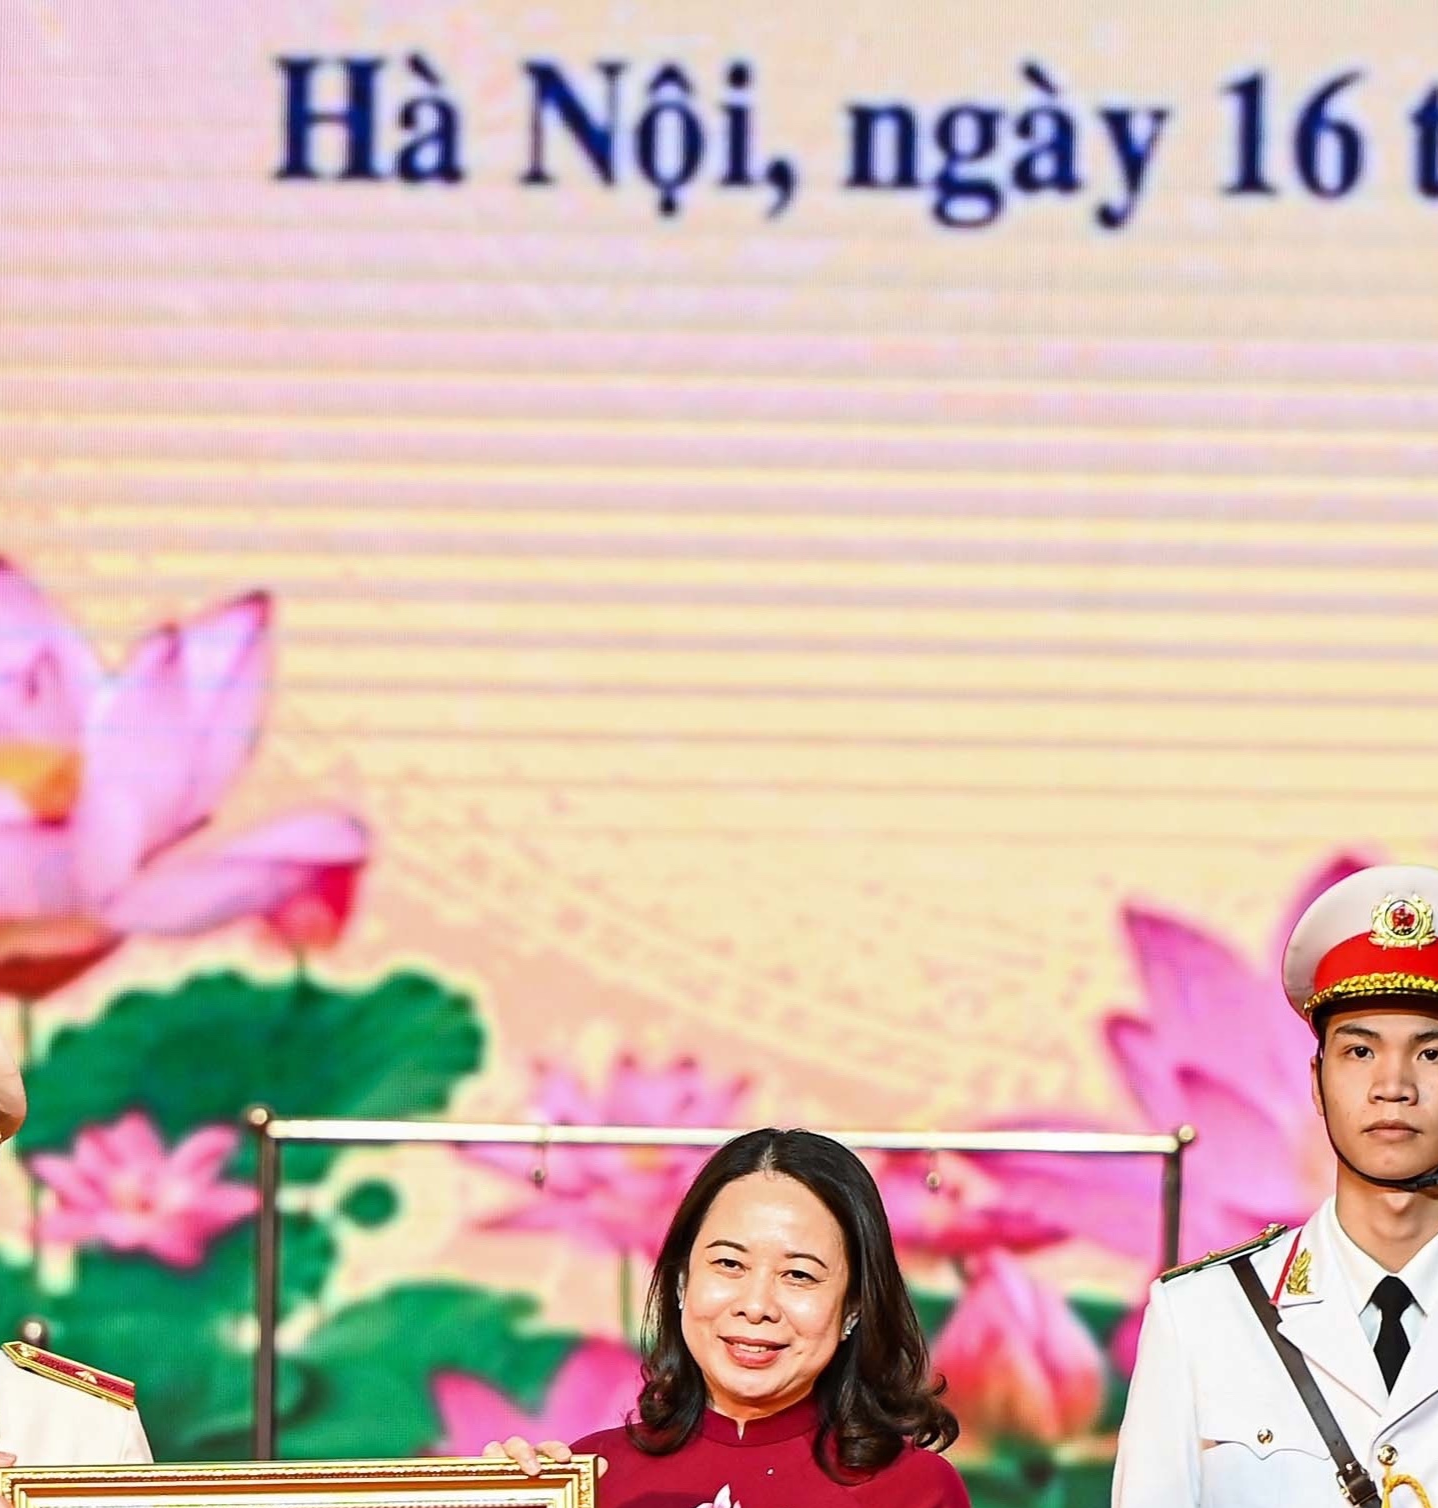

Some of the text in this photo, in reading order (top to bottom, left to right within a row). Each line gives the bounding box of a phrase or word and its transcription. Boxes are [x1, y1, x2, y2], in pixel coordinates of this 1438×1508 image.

[274, 52, 465, 184] Hà
[518, 61, 797, 218] Nội,
[842, 61, 1171, 229] ngày
[1220, 68, 1367, 201] 16
